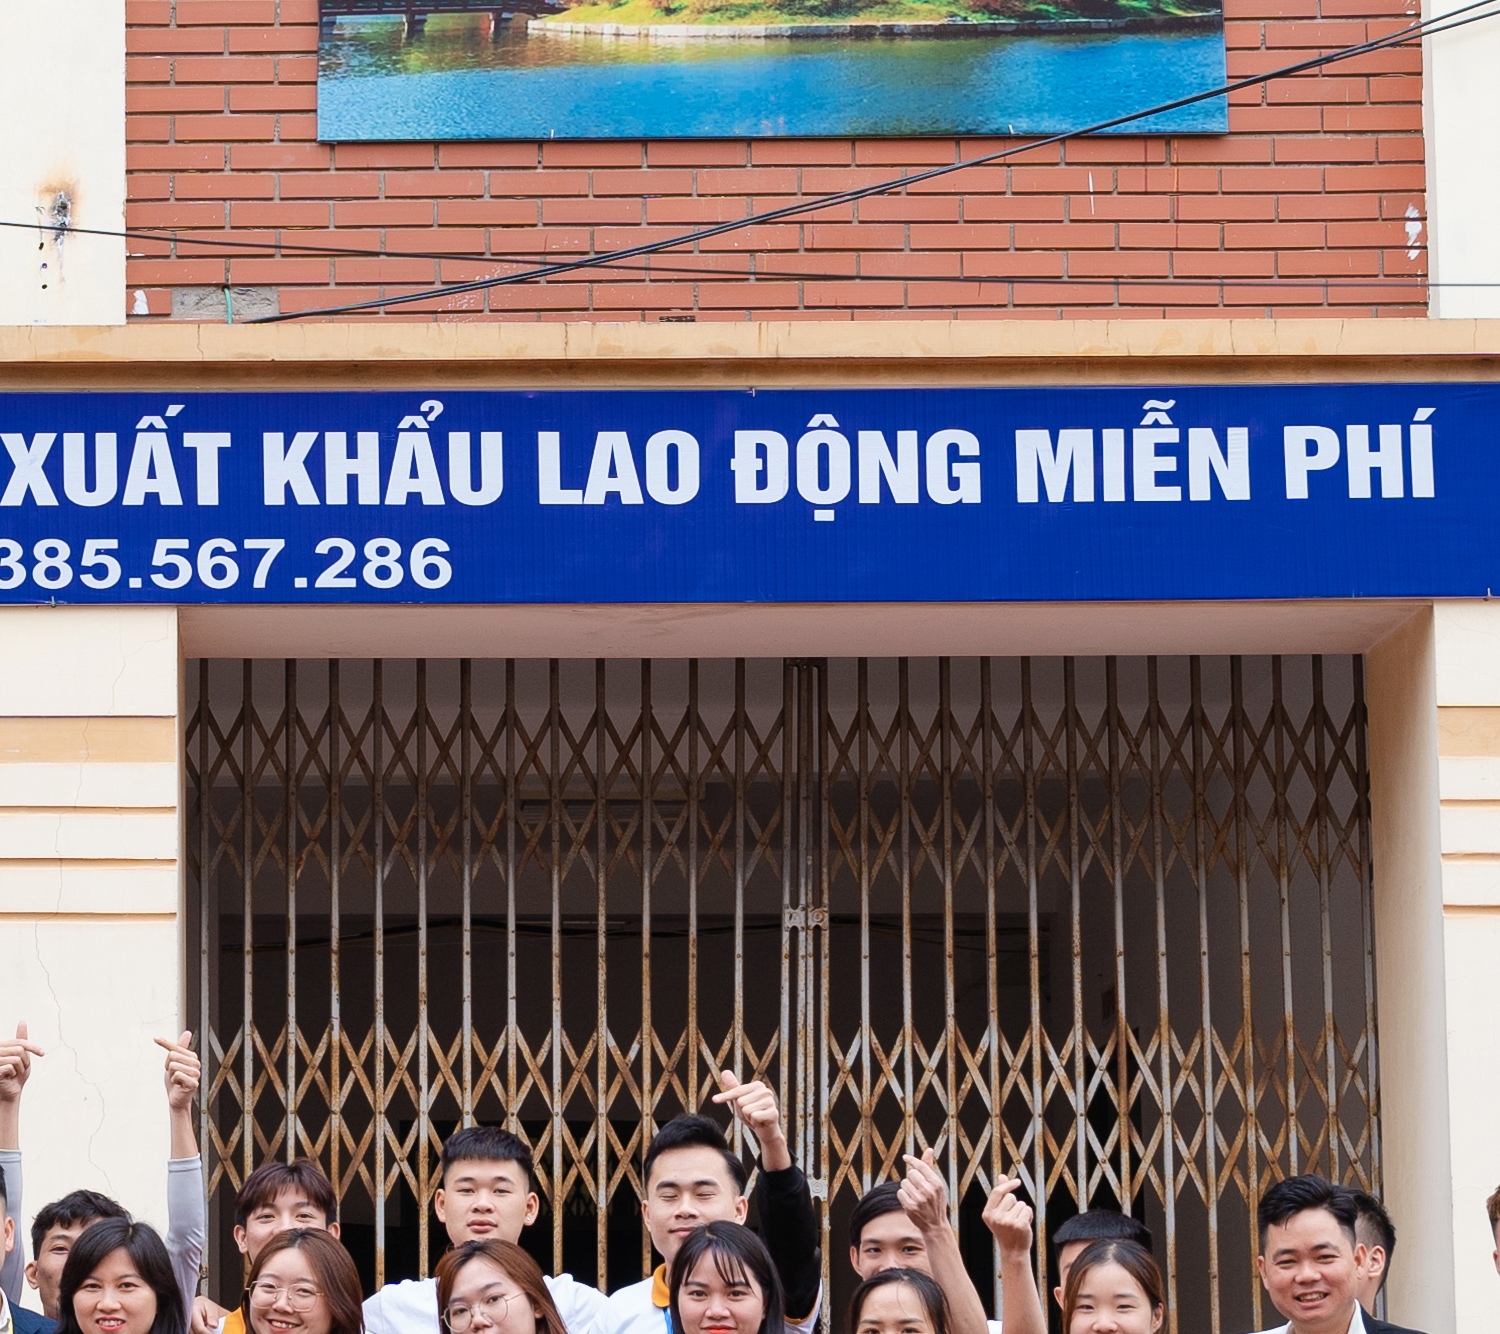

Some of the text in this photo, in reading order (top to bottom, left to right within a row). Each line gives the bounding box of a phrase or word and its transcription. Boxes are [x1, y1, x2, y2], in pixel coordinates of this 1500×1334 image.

[0, 404, 231, 506] XUẤT
[263, 400, 503, 505] KHẨU
[538, 430, 699, 504] LAO
[731, 414, 981, 521] ĐỘNG
[1016, 399, 1250, 502] MIỄN
[1284, 408, 1436, 499] PHÍ
